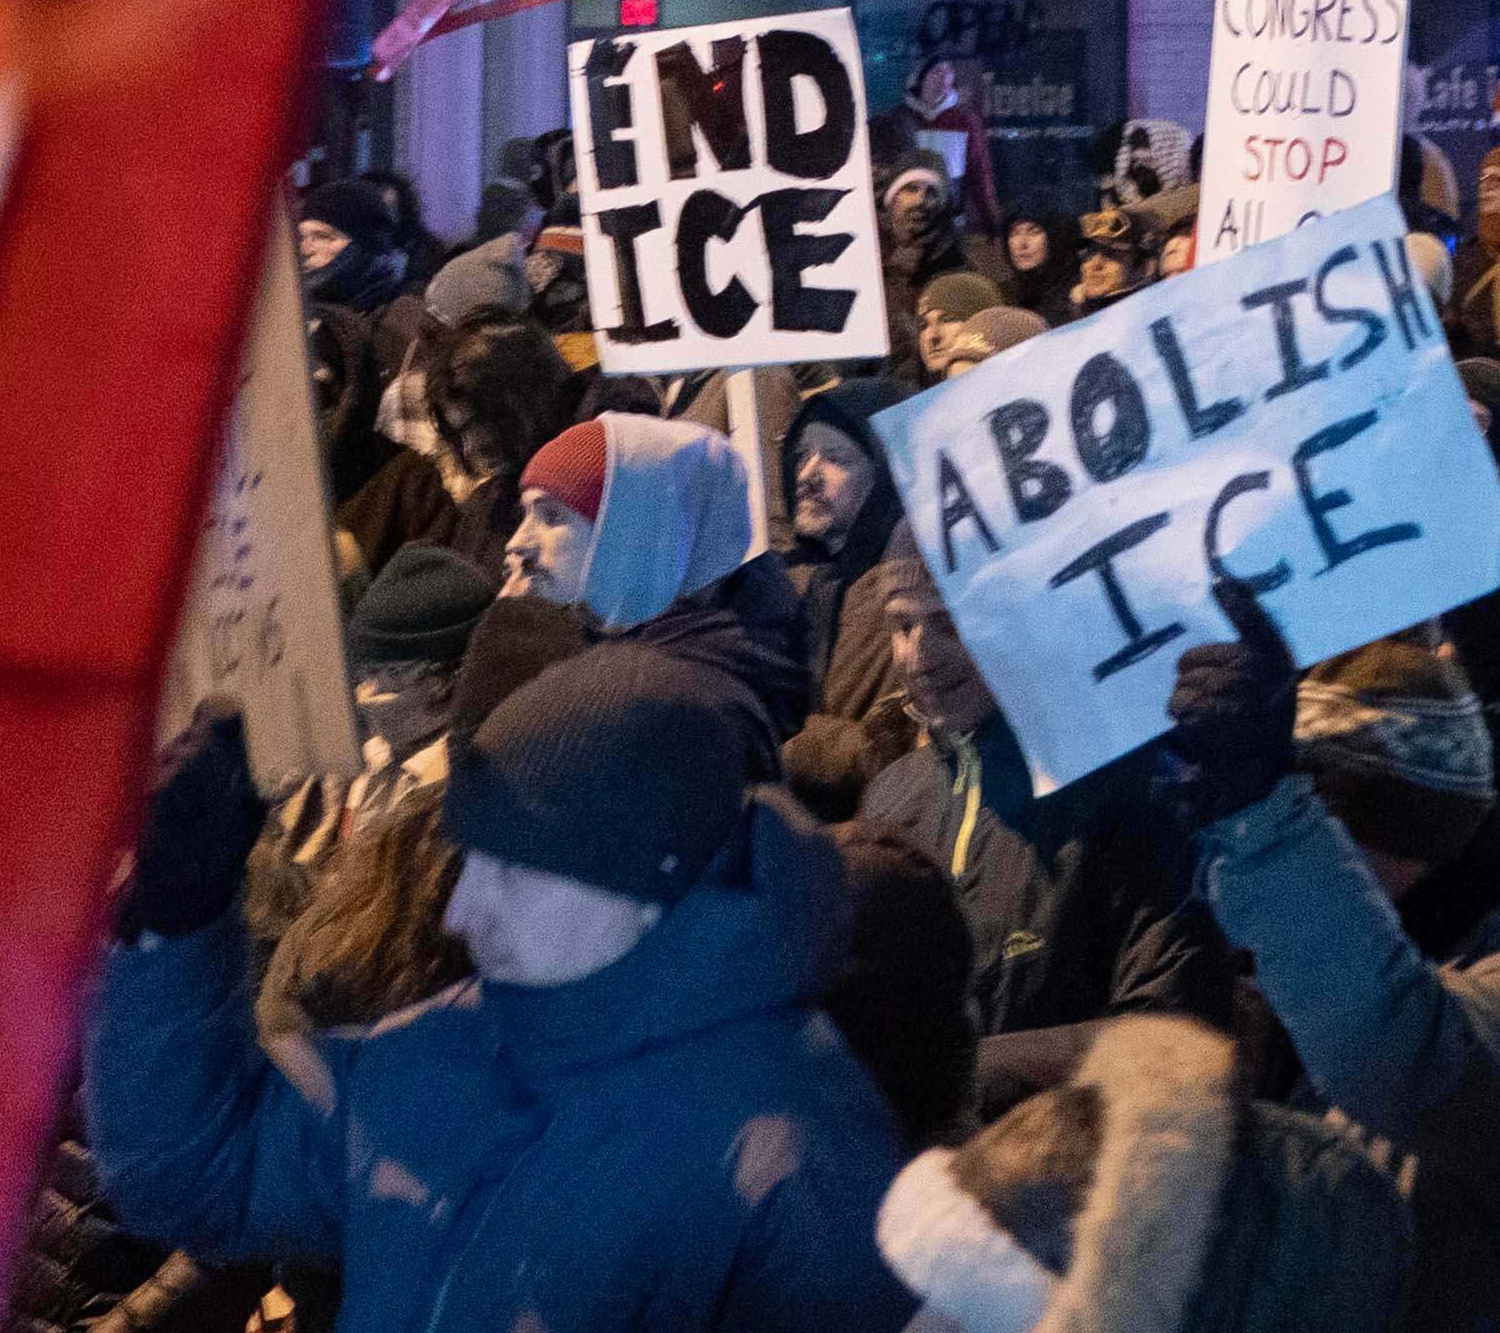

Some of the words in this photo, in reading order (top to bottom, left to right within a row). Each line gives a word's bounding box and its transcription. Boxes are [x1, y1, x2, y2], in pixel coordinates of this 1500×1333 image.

[584, 28, 856, 190] END
[1231, 61, 1357, 117] COULD
[1242, 134, 1348, 184] STOP
[595, 188, 858, 344] ICE
[933, 237, 1433, 574] ABOLISH
[1047, 407, 1422, 684] ICE
